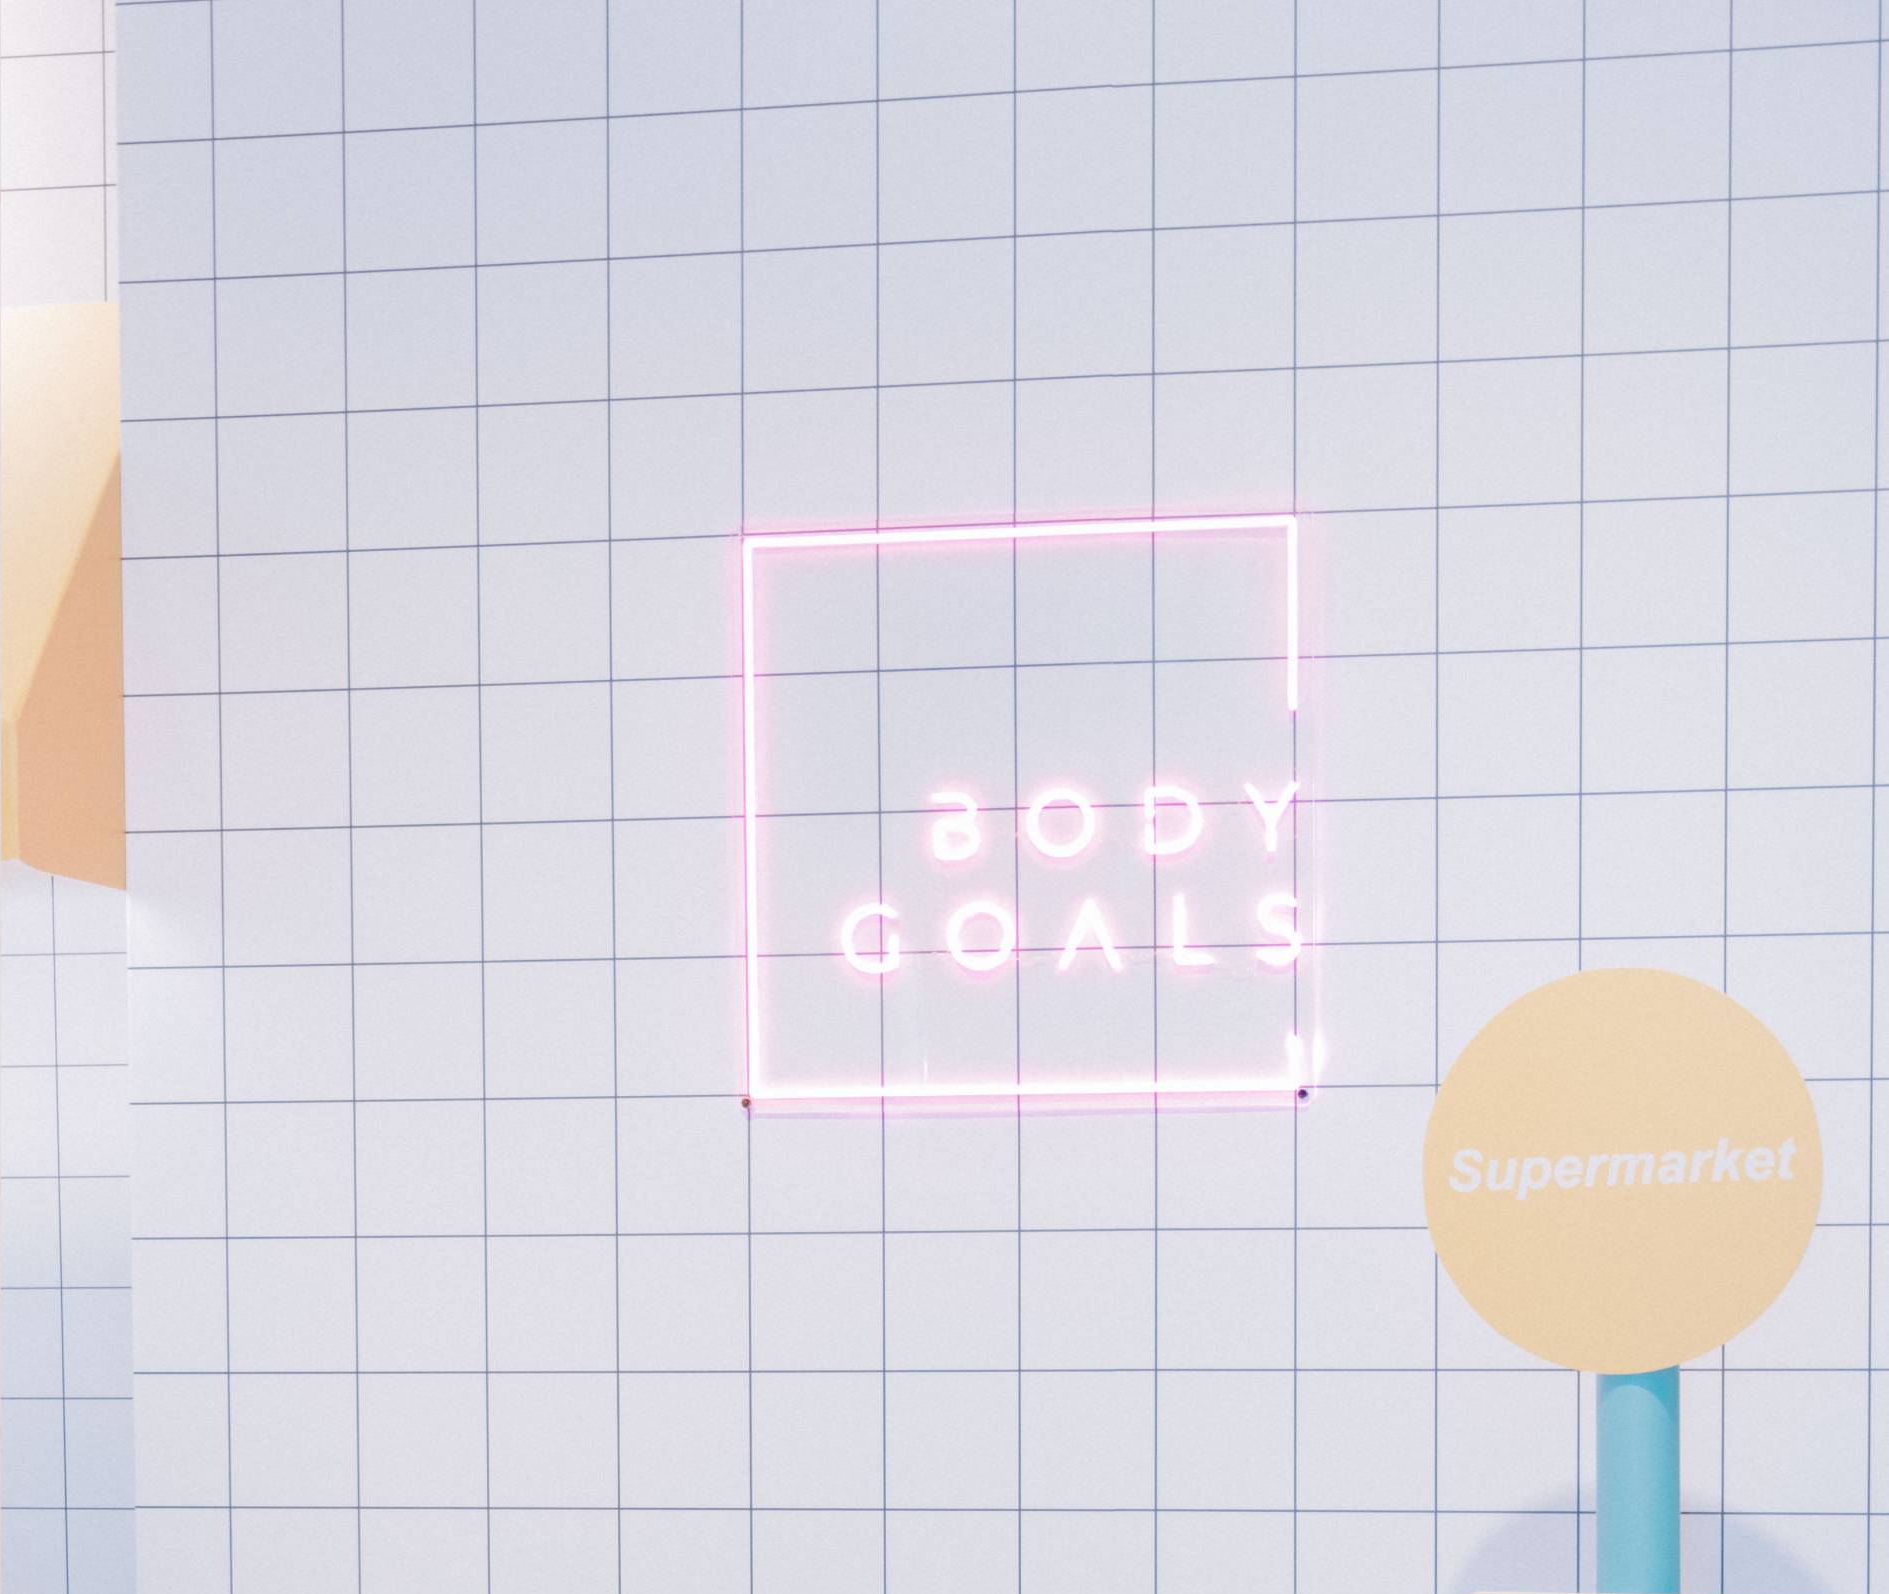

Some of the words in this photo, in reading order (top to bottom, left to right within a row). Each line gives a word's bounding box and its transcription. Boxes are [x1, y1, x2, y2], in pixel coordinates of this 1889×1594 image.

[931, 780, 1300, 861] BODY
[841, 894, 1303, 974] GOALS
[1448, 1137, 1797, 1201] Supermarket
